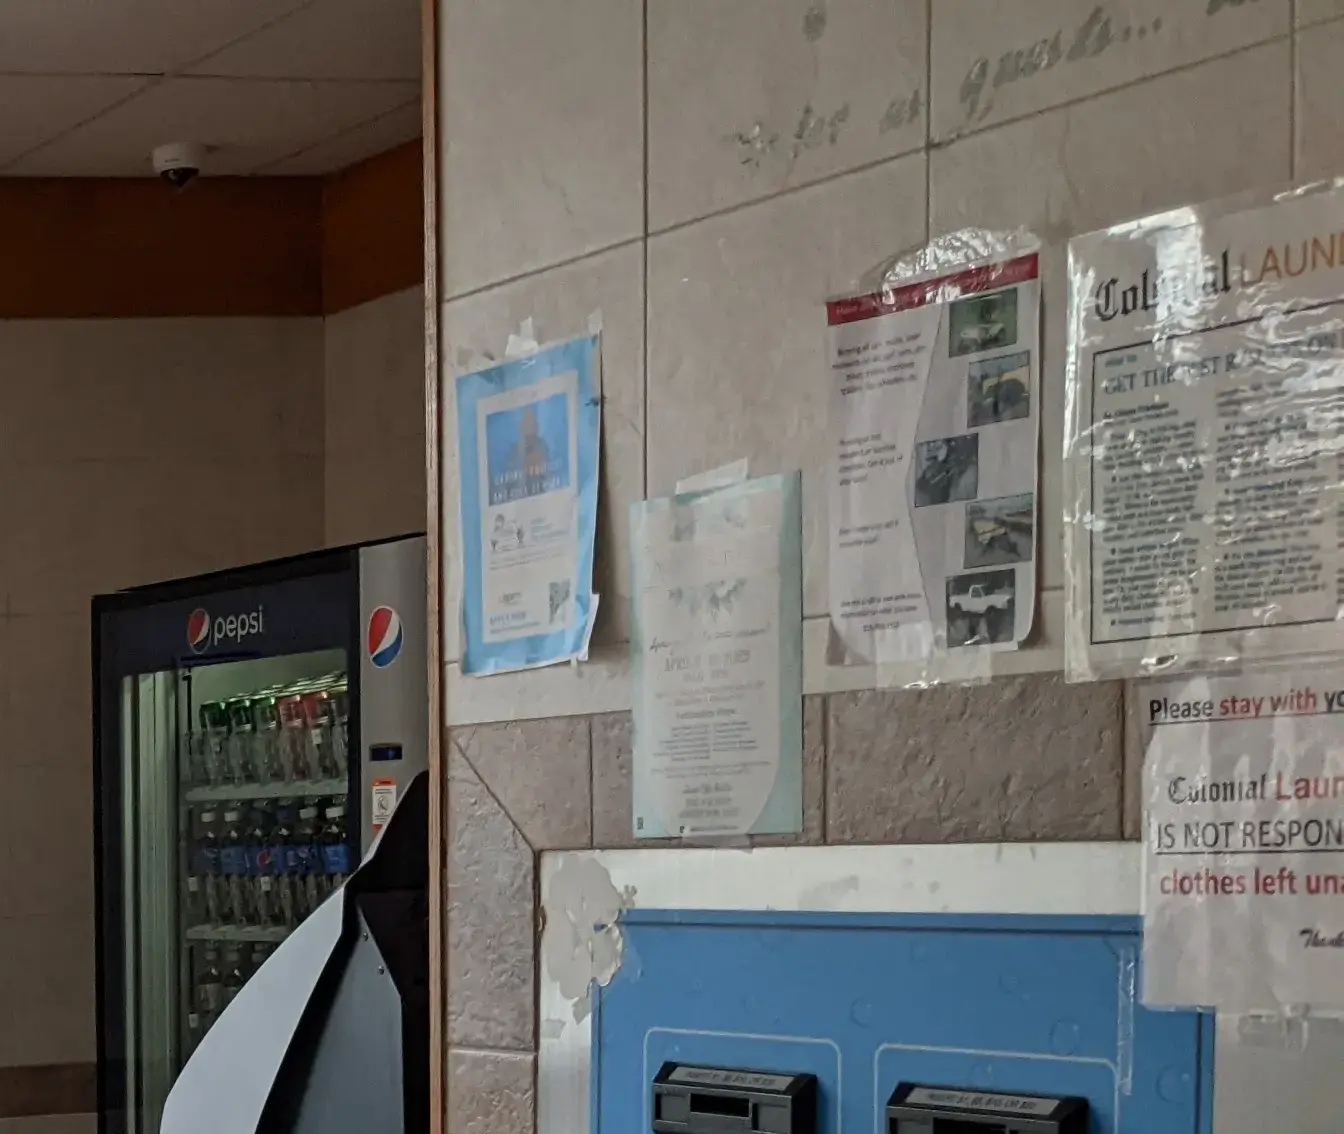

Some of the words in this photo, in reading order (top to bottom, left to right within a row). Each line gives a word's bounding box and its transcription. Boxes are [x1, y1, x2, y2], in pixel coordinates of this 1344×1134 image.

[1094, 248, 1232, 322] Colal
[214, 604, 263, 647] pepsi
[1149, 699, 1214, 722] Please
[1219, 695, 1264, 720] stay
[1270, 687, 1318, 711] with
[1157, 823, 1176, 850] IS
[1184, 821, 1235, 849] NOT
[1242, 819, 1342, 849] RESPON
[1160, 867, 1247, 896] clothes
[1254, 866, 1298, 896] left
